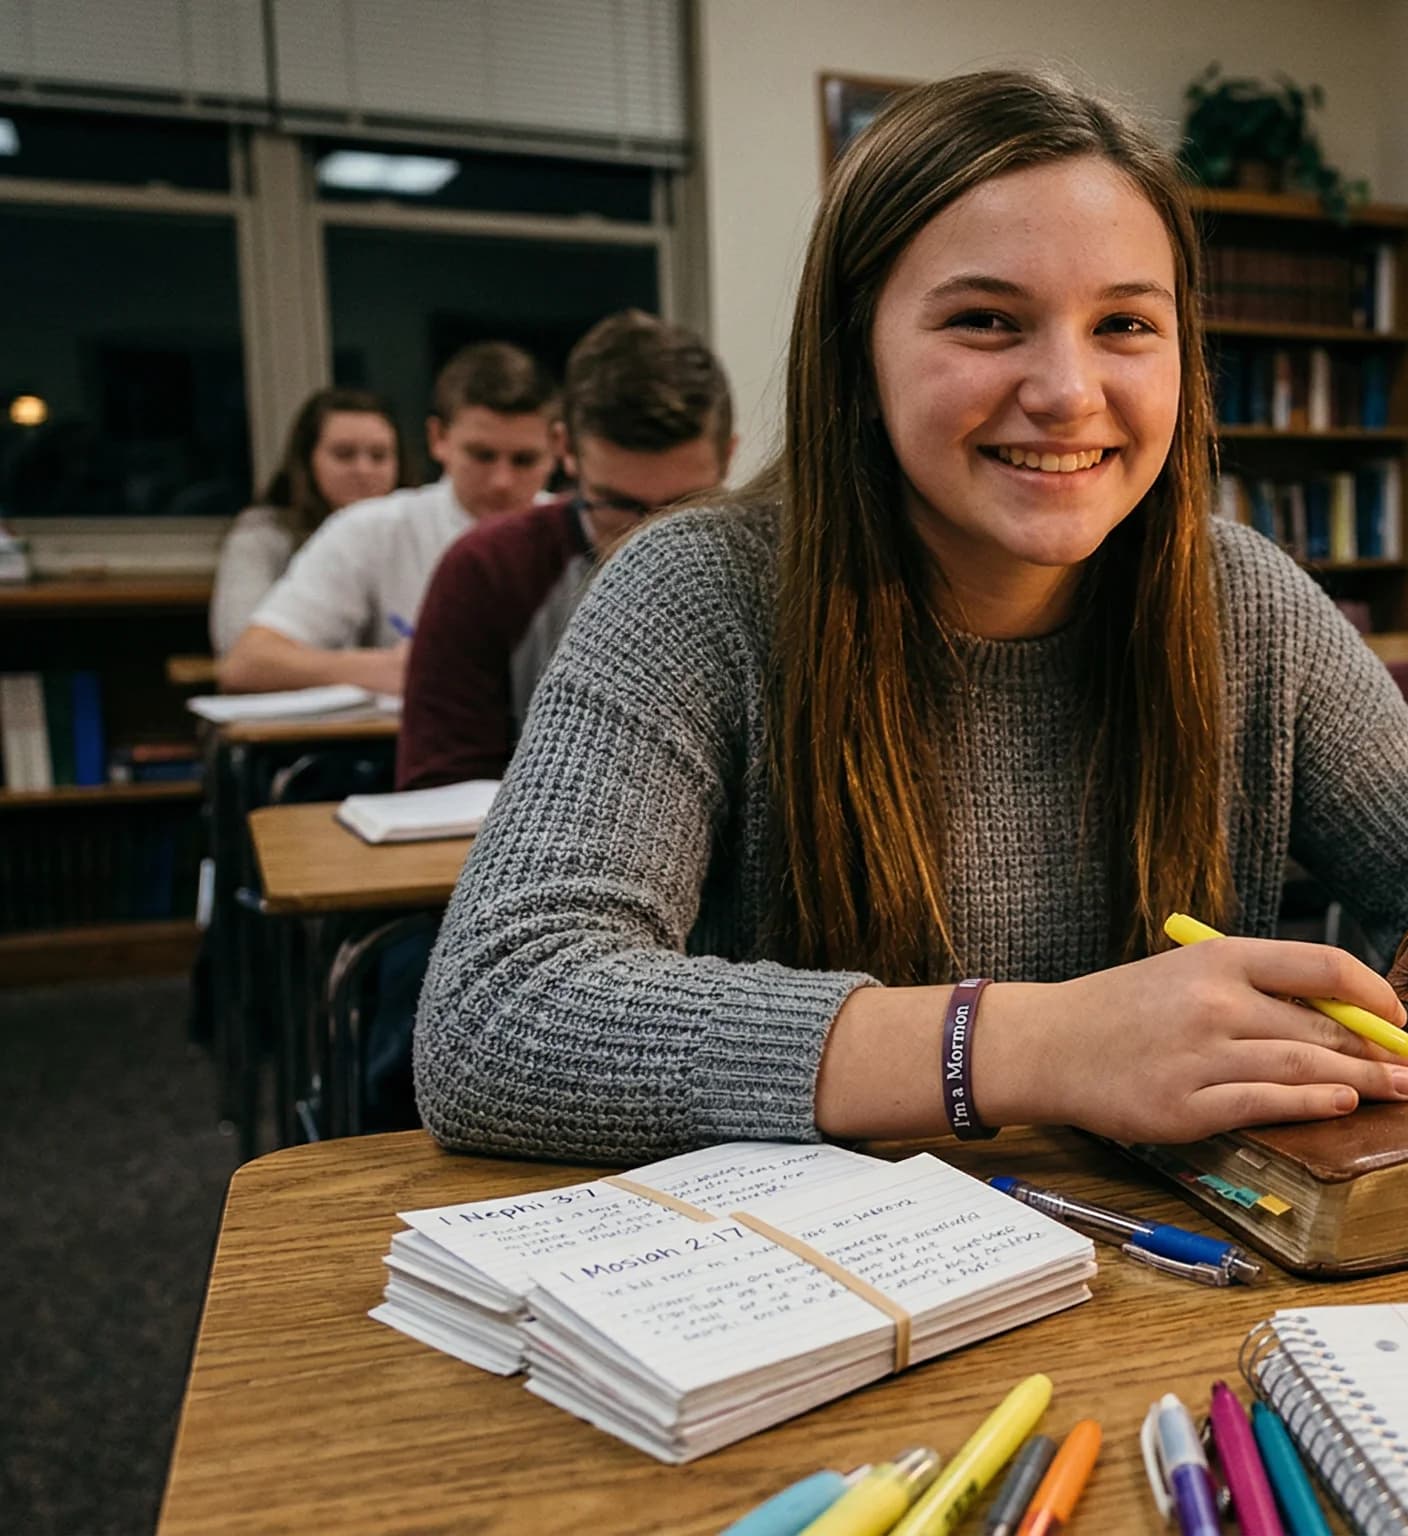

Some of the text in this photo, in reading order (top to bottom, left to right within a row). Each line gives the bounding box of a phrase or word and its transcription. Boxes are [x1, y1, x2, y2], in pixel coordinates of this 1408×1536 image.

[946, 1005, 971, 1127] I'm a Mormon
[459, 1200, 544, 1225] Nephi
[551, 1188, 597, 1205] 3:7
[581, 1247, 681, 1280] Mosiah
[685, 1227, 744, 1251] 2:17
